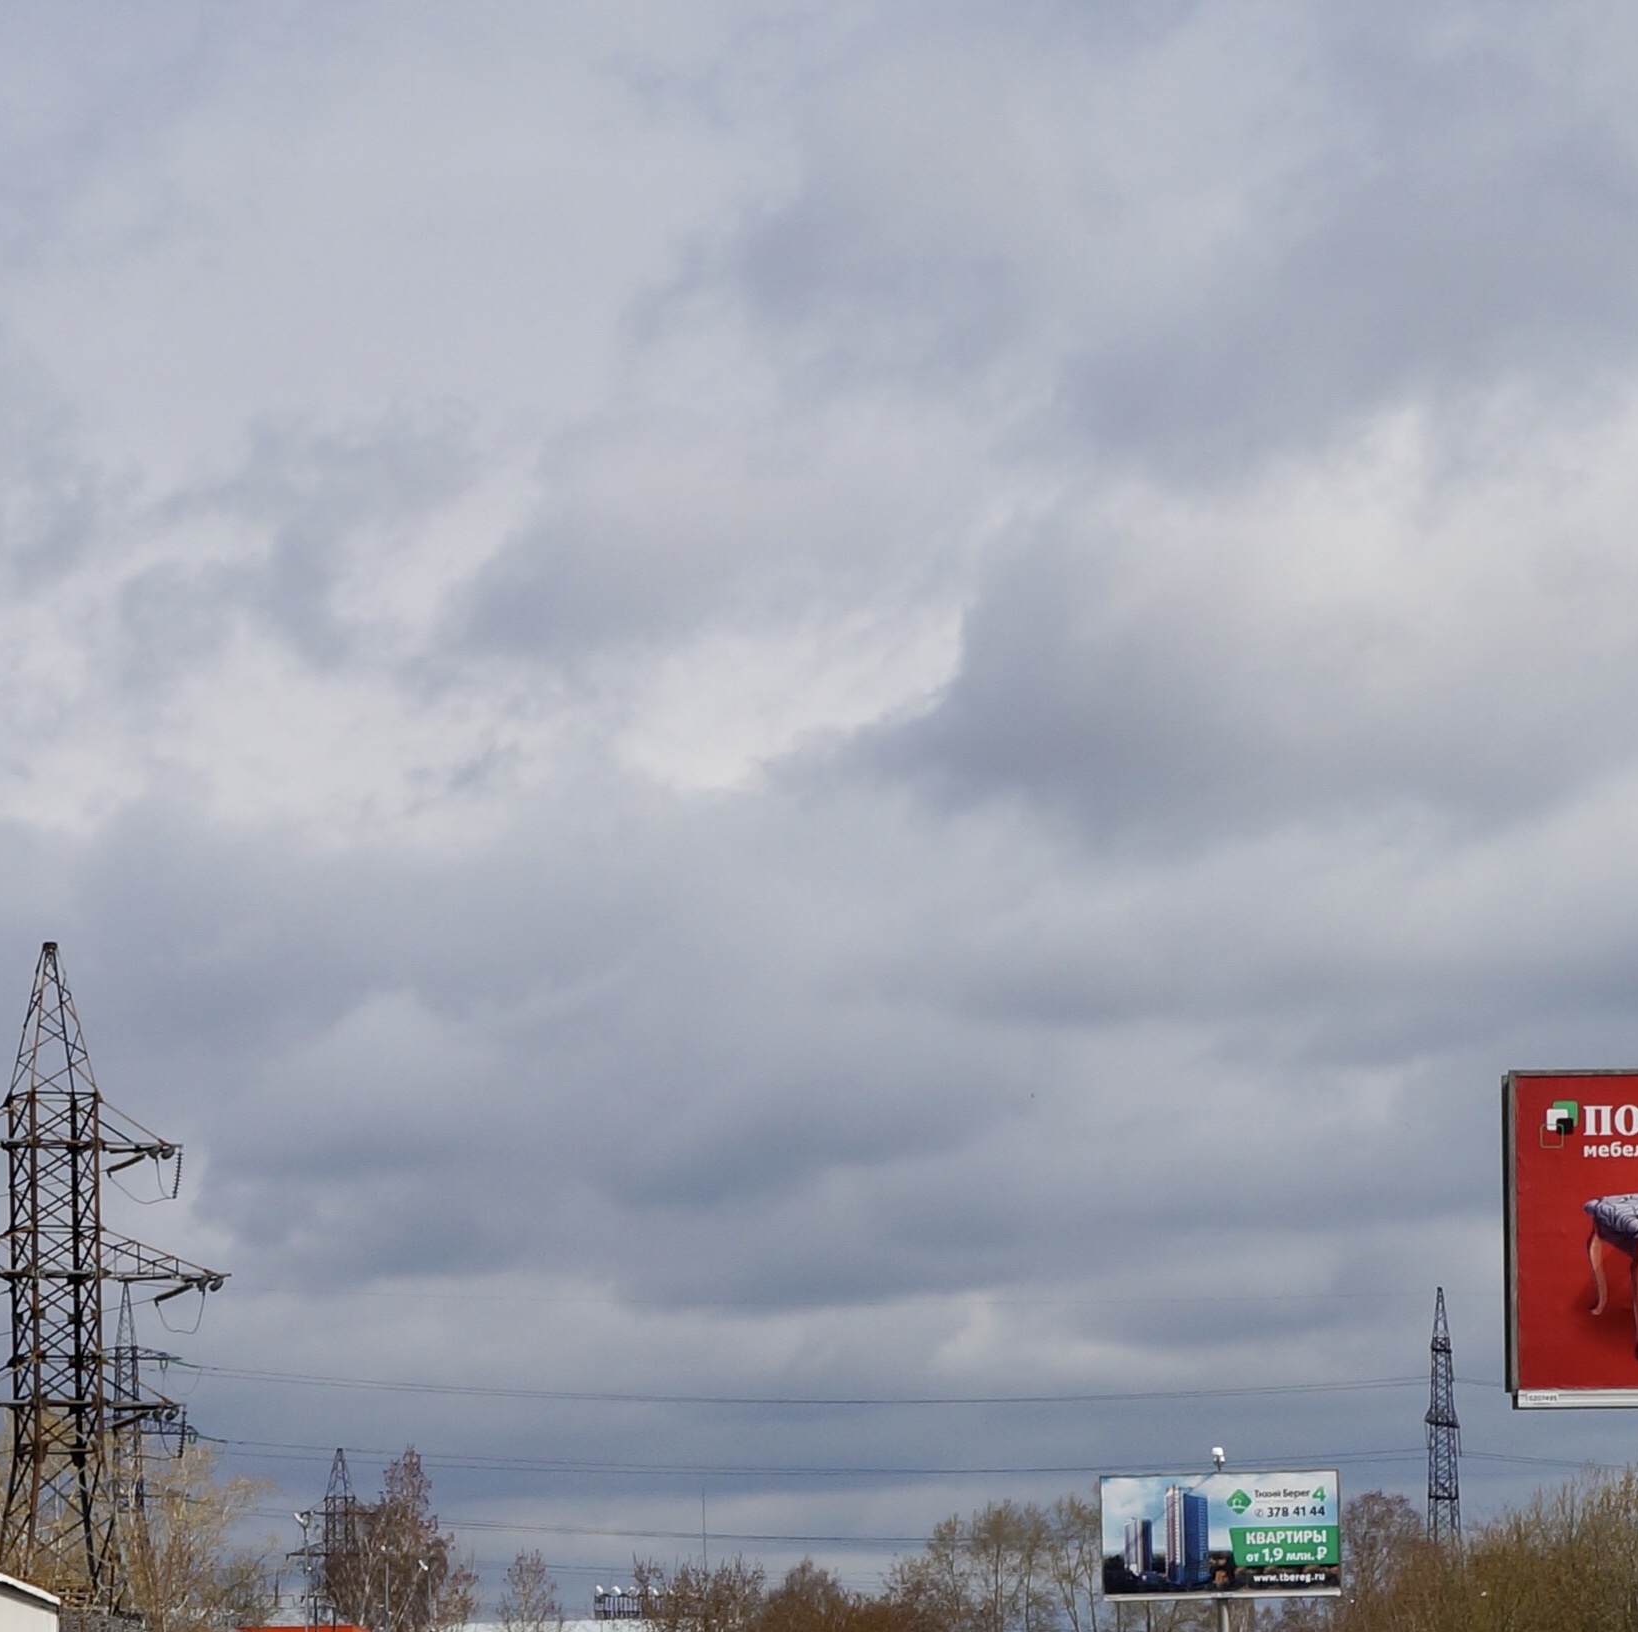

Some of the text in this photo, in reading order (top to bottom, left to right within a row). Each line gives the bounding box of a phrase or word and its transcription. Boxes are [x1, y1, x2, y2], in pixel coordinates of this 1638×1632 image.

[1283, 1489, 1310, 1499] Берег
[1312, 1485, 1327, 1502] 4
[1267, 1505, 1325, 1517] 378 41 44
[1246, 1530, 1327, 1545] КВАРТИРЫ
[1246, 1553, 1259, 1562] от
[1262, 1548, 1283, 1563] 1,9
[1286, 1552, 1315, 1561] млн.
[1253, 1573, 1325, 1583] www.tbereg.ru
